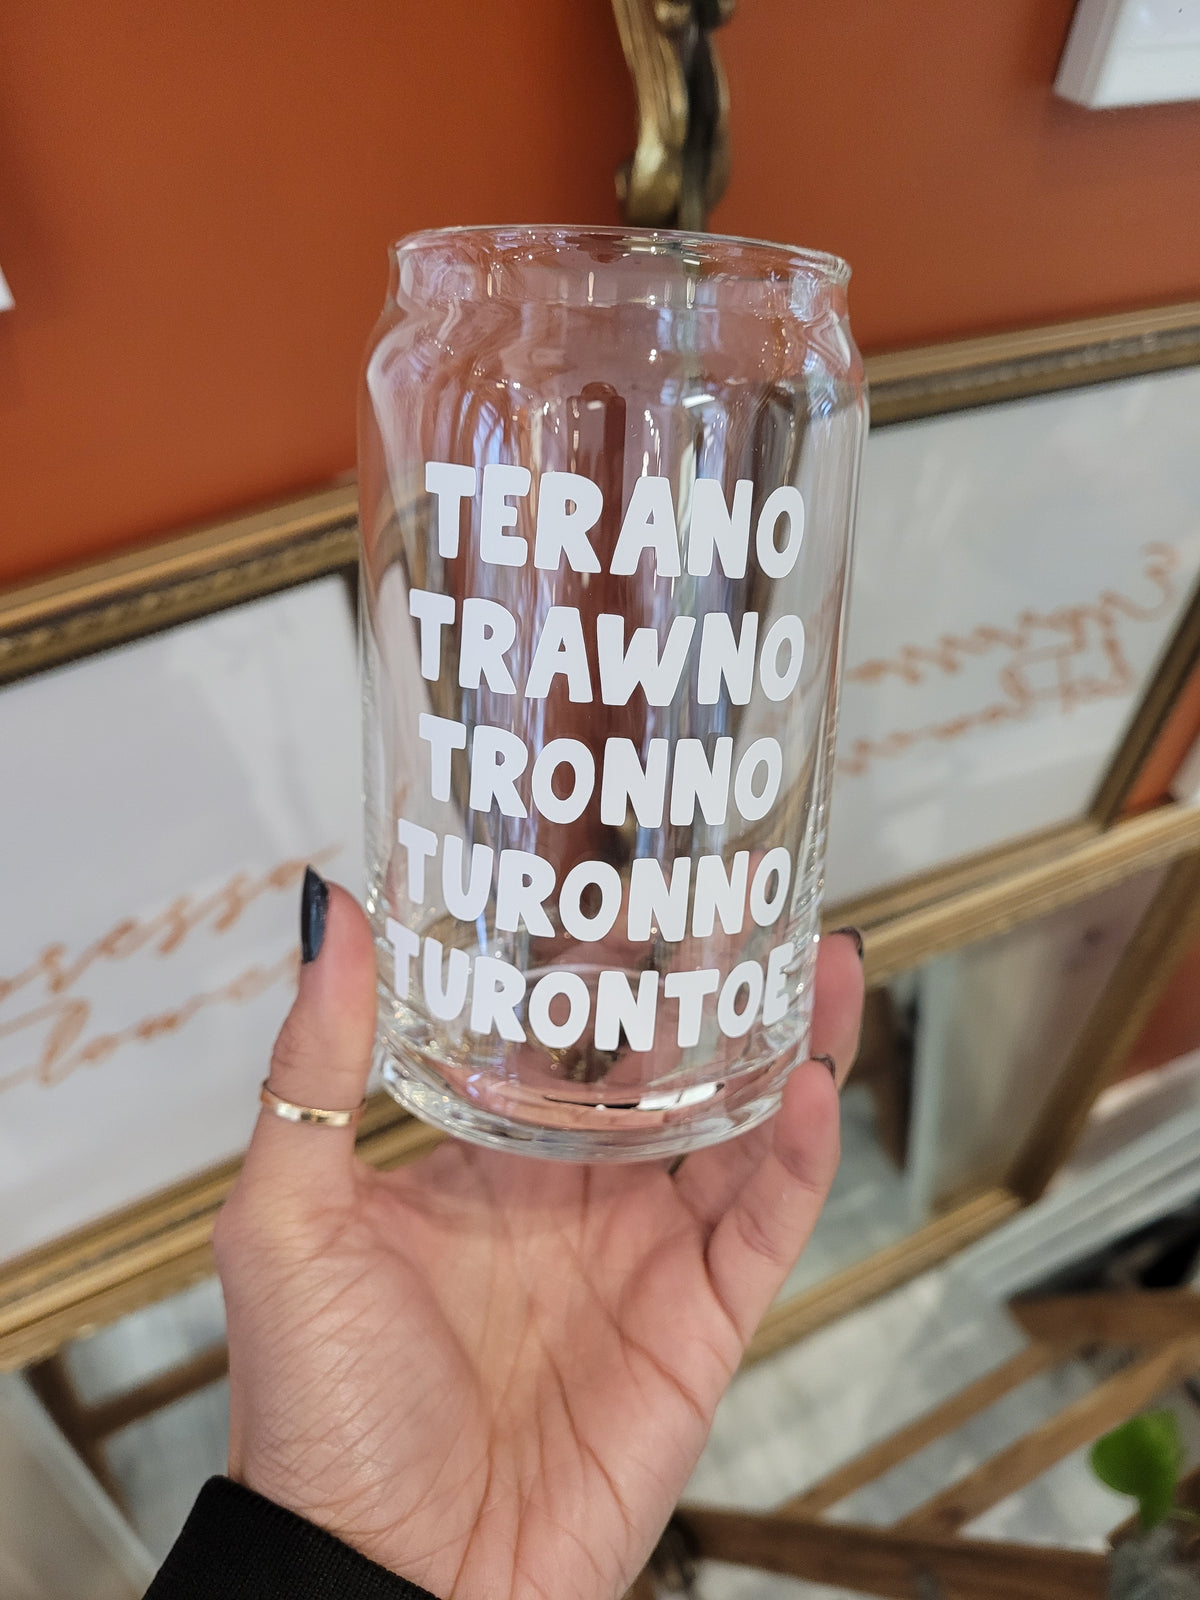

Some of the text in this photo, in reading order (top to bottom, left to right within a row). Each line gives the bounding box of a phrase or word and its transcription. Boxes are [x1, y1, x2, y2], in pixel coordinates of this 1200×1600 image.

[425, 461, 804, 578] TERANO
[409, 588, 804, 706] TRAWNO
[418, 713, 783, 828] TRONNO
[398, 818, 791, 942] TURONNO
[386, 917, 795, 1051] TURONTOE
